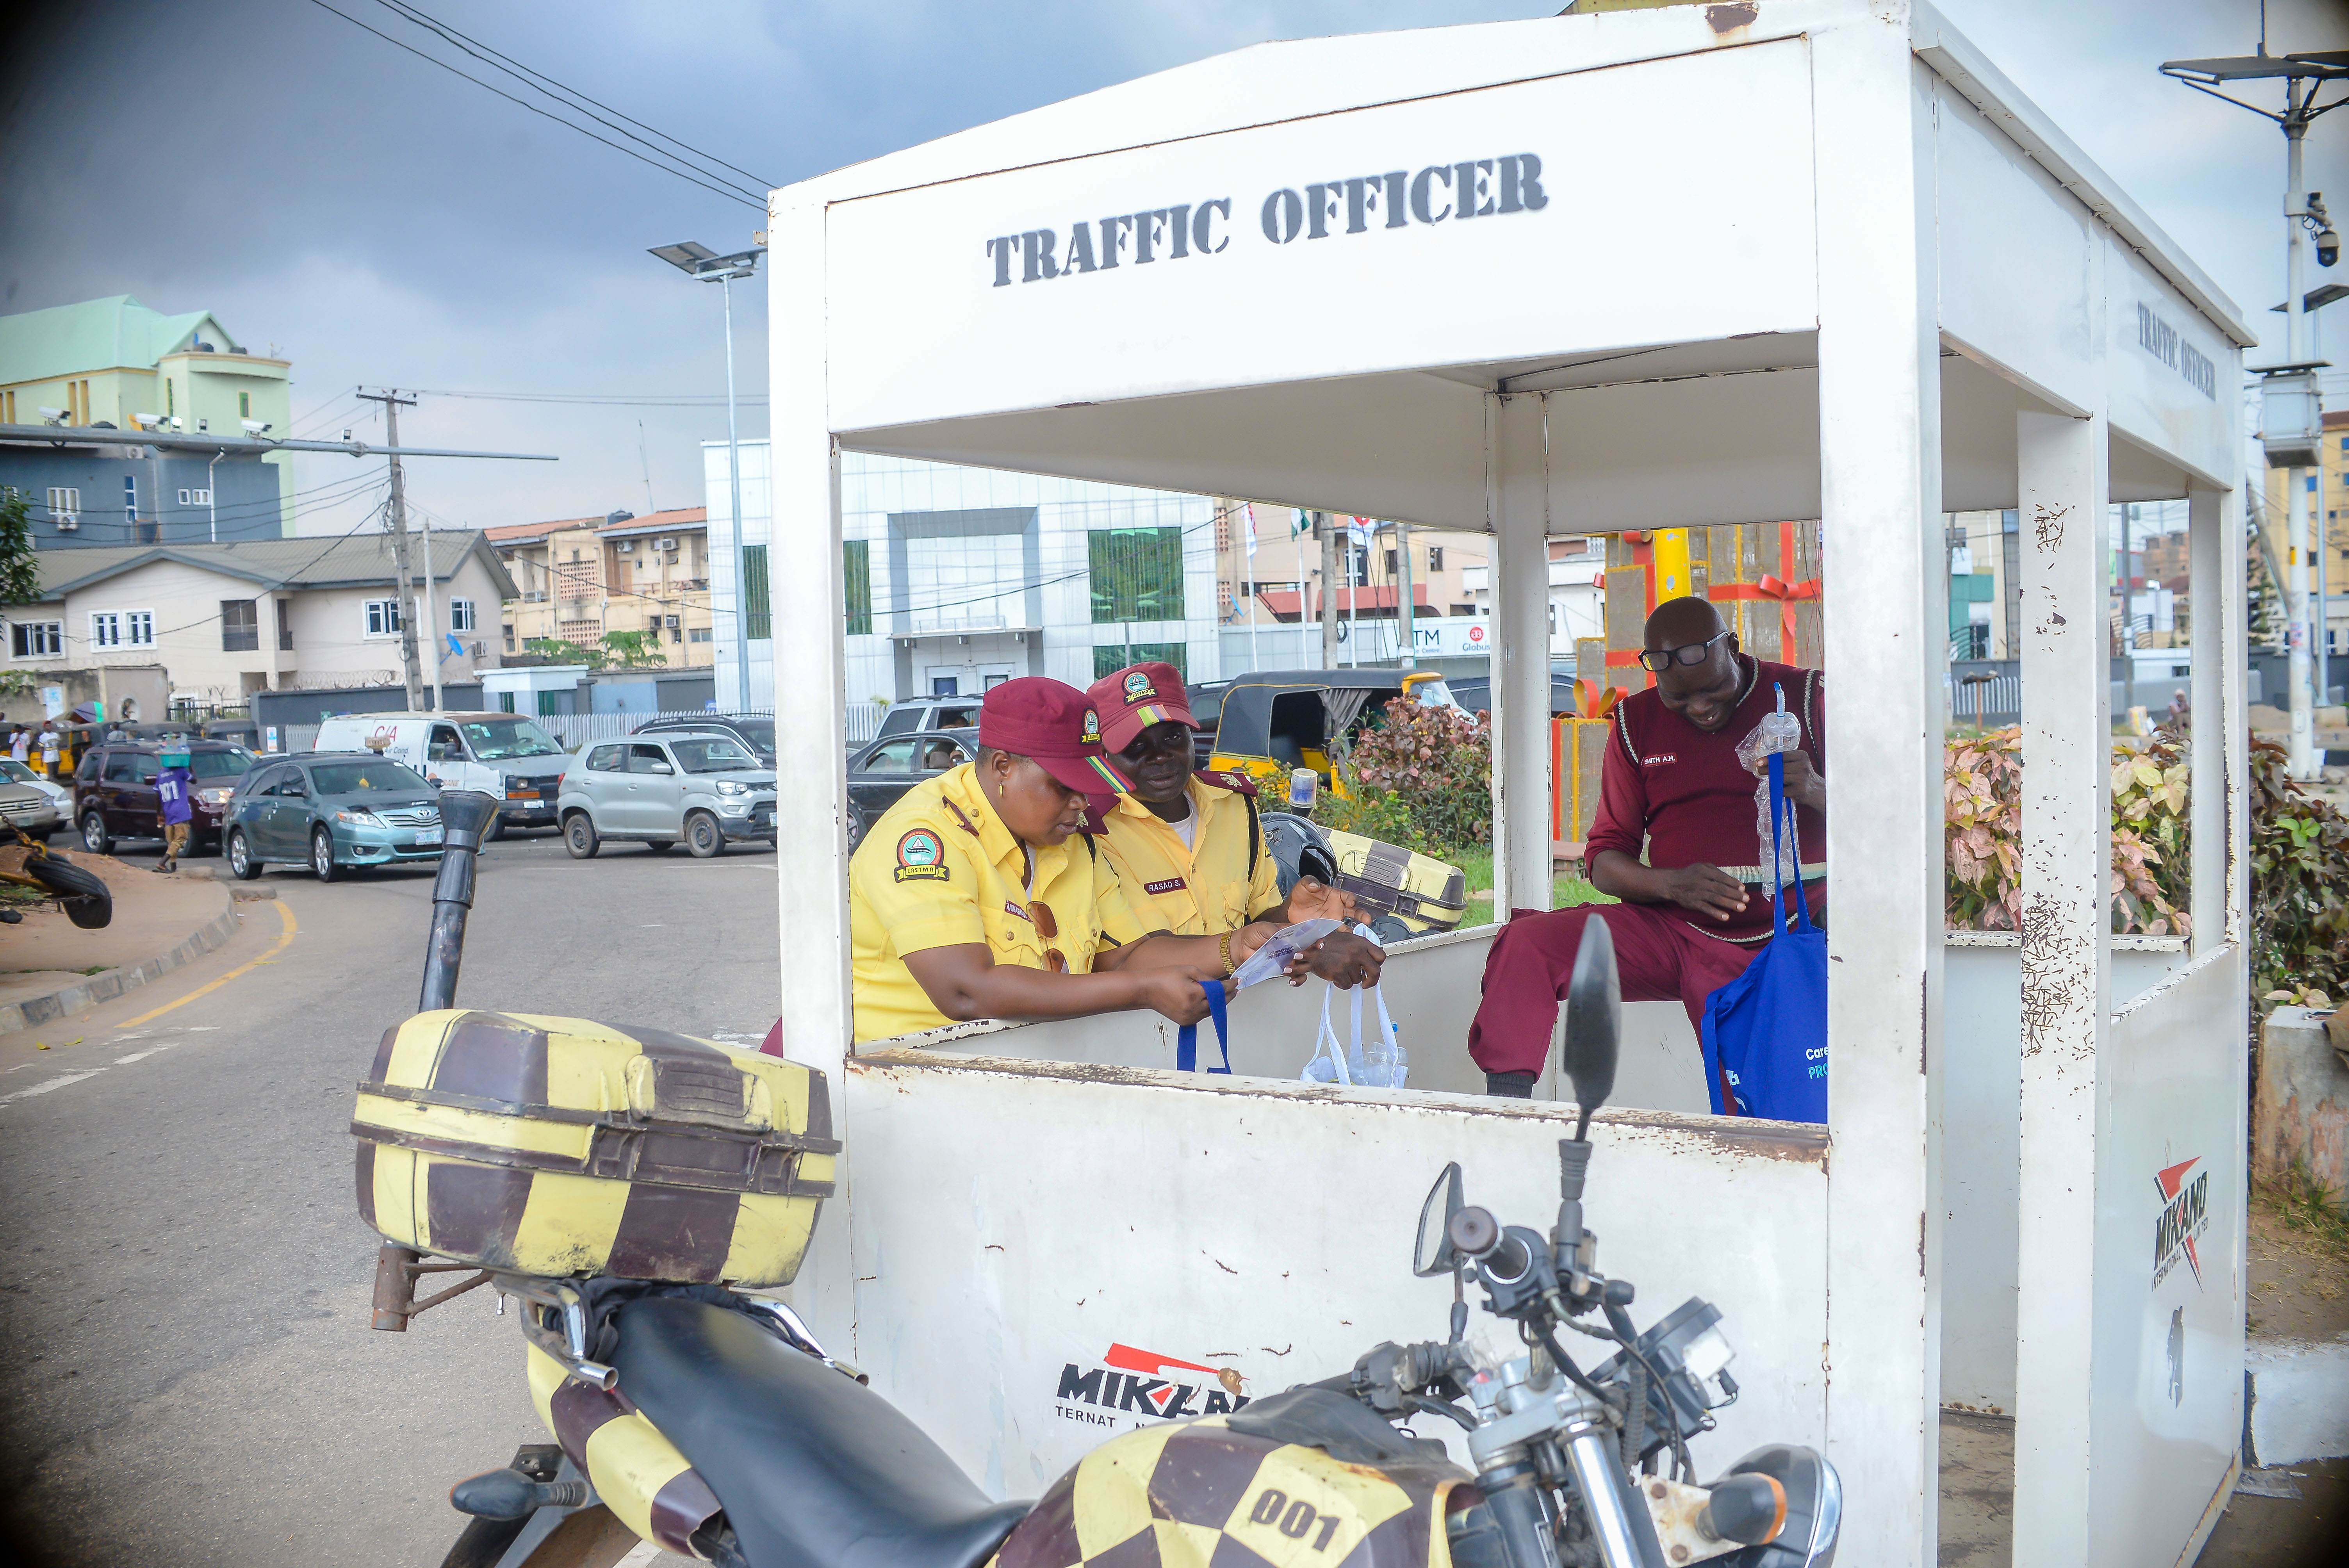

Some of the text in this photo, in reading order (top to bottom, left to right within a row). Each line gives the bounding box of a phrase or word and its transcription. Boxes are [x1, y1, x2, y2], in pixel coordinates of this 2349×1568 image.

[987, 153, 1549, 287] TRAFFIC OFFICER
[2137, 300, 2216, 402] TRAFFIC OFFICER
[1414, 630, 1440, 645] TM
[159, 780, 179, 802] 101
[1149, 881, 1173, 891] RASAQ
[2154, 1171, 2208, 1272] MIKANO
[1250, 1489, 1340, 1552] 001
